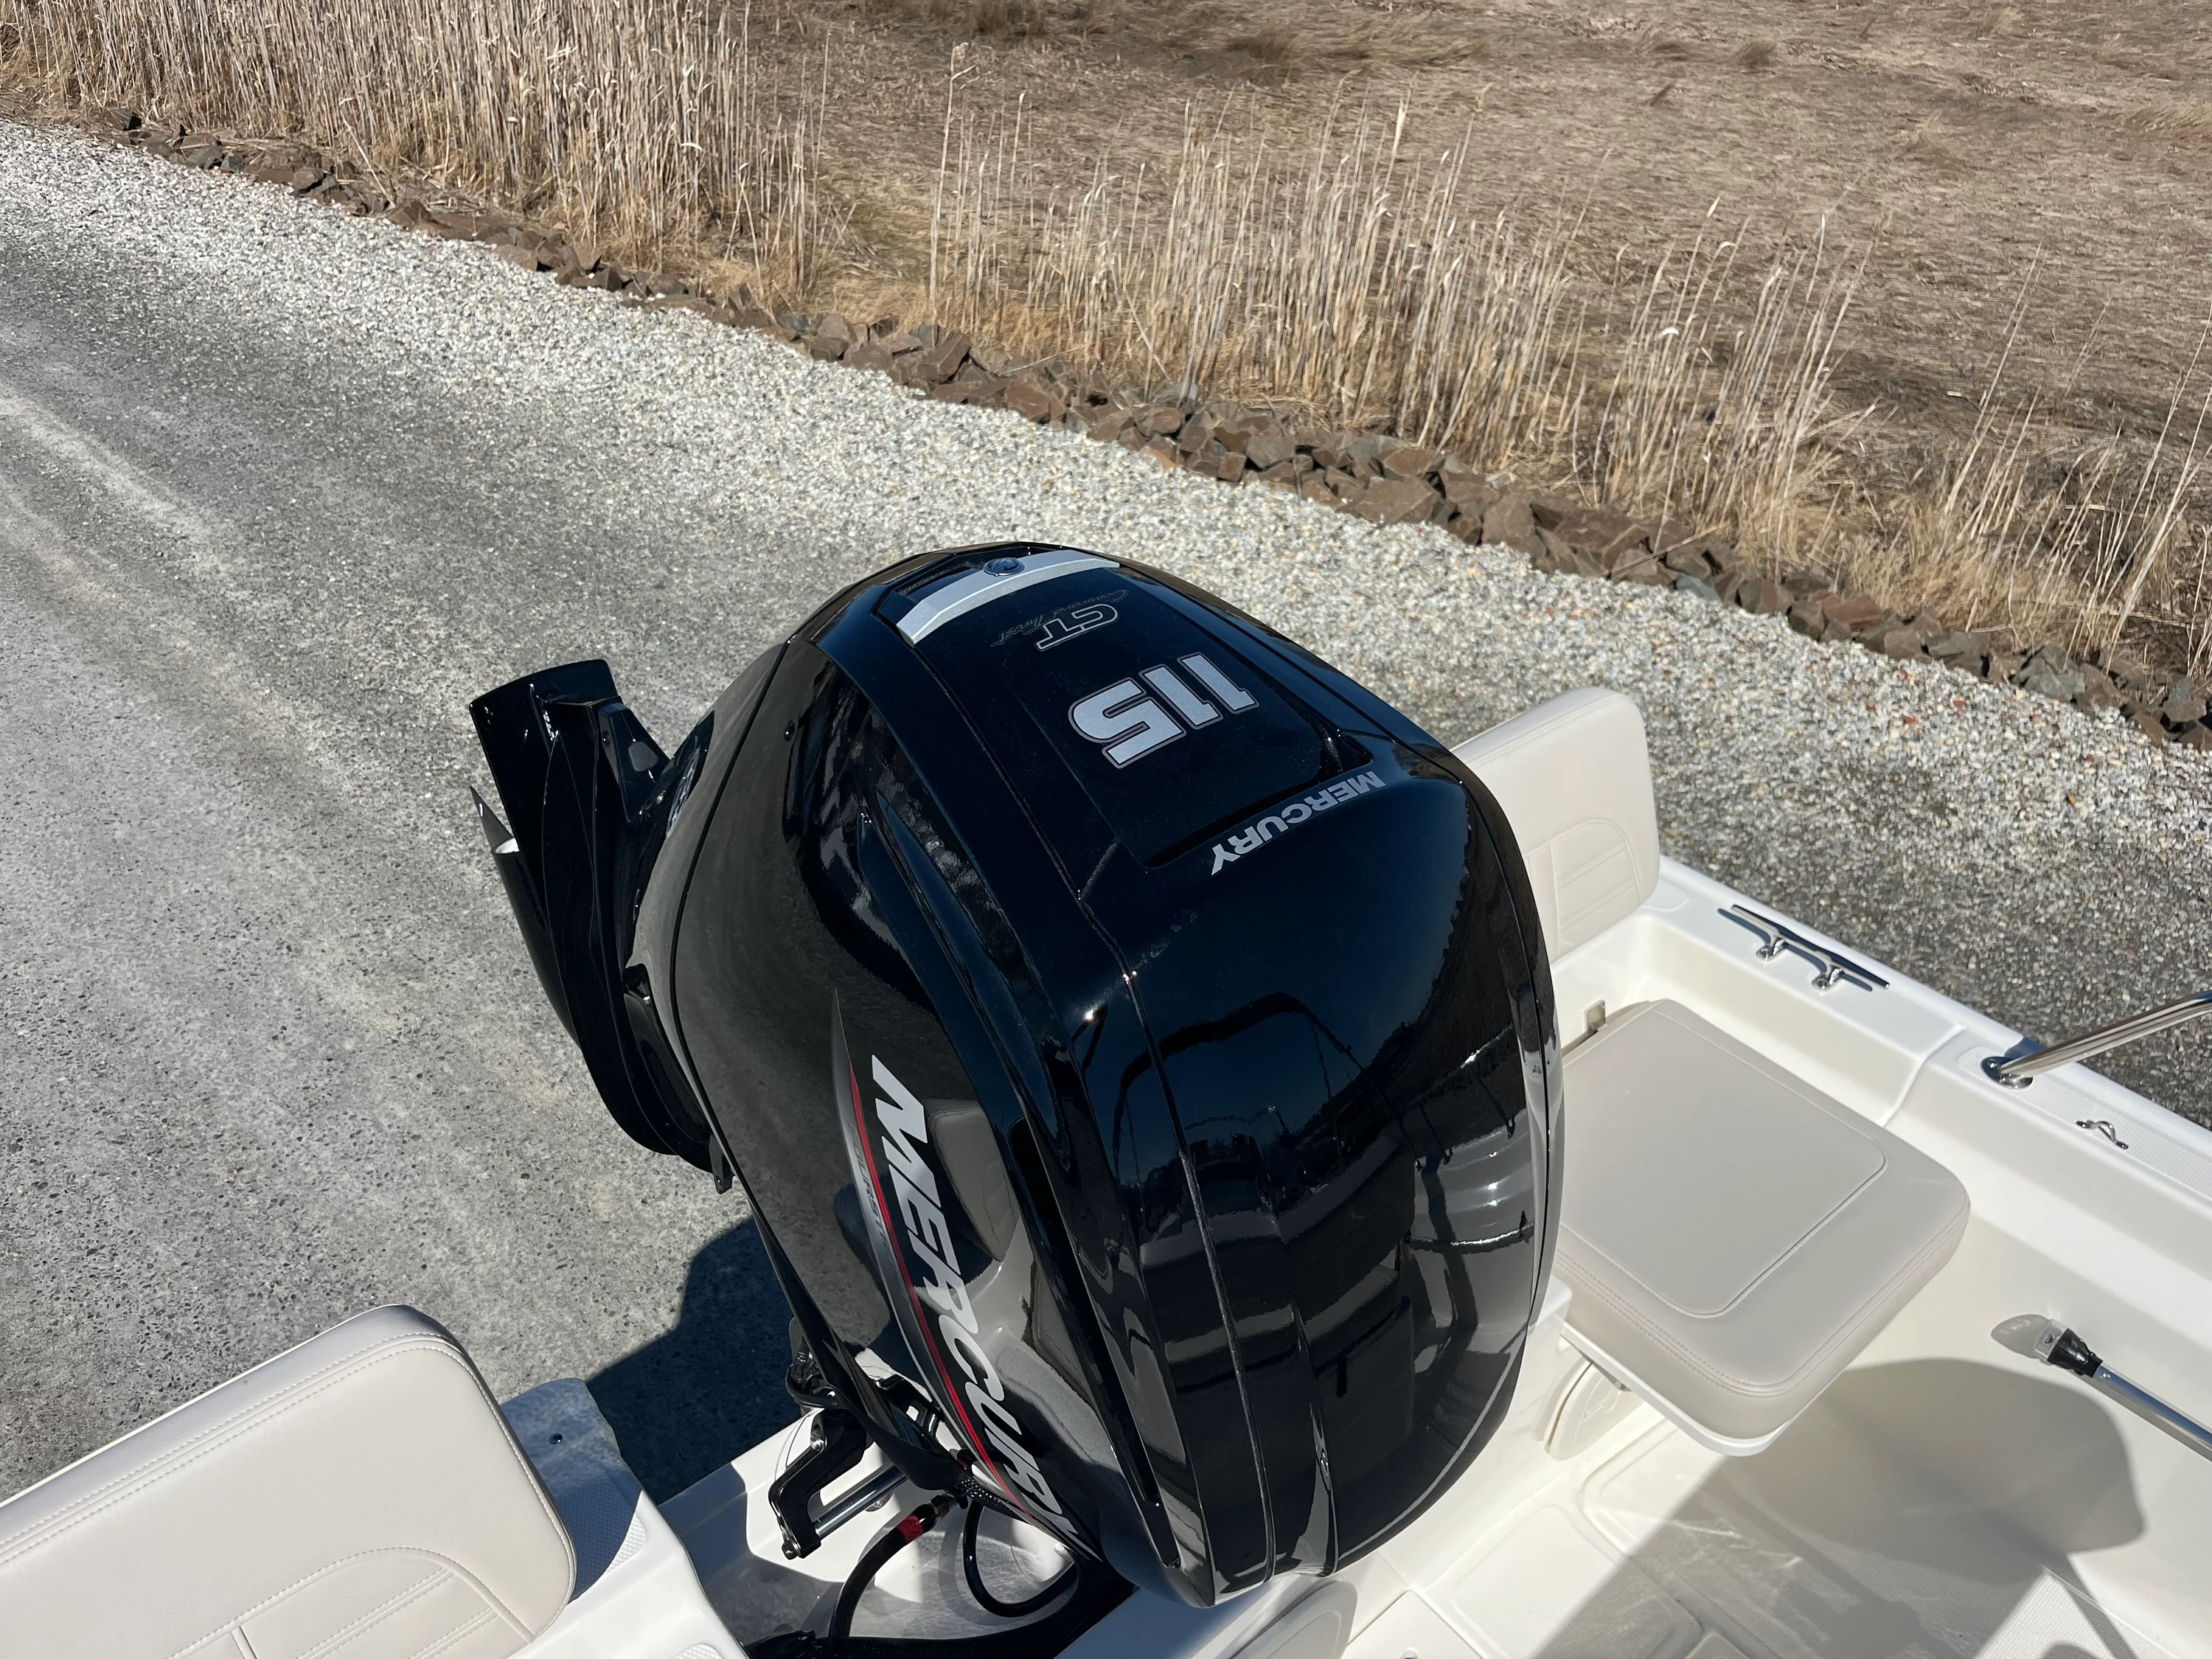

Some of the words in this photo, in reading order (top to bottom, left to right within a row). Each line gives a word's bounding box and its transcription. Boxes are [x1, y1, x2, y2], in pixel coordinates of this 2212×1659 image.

[1034, 603, 1119, 651] GT
[1068, 653, 1259, 768] 115
[1211, 771, 1387, 876] MERCURY
